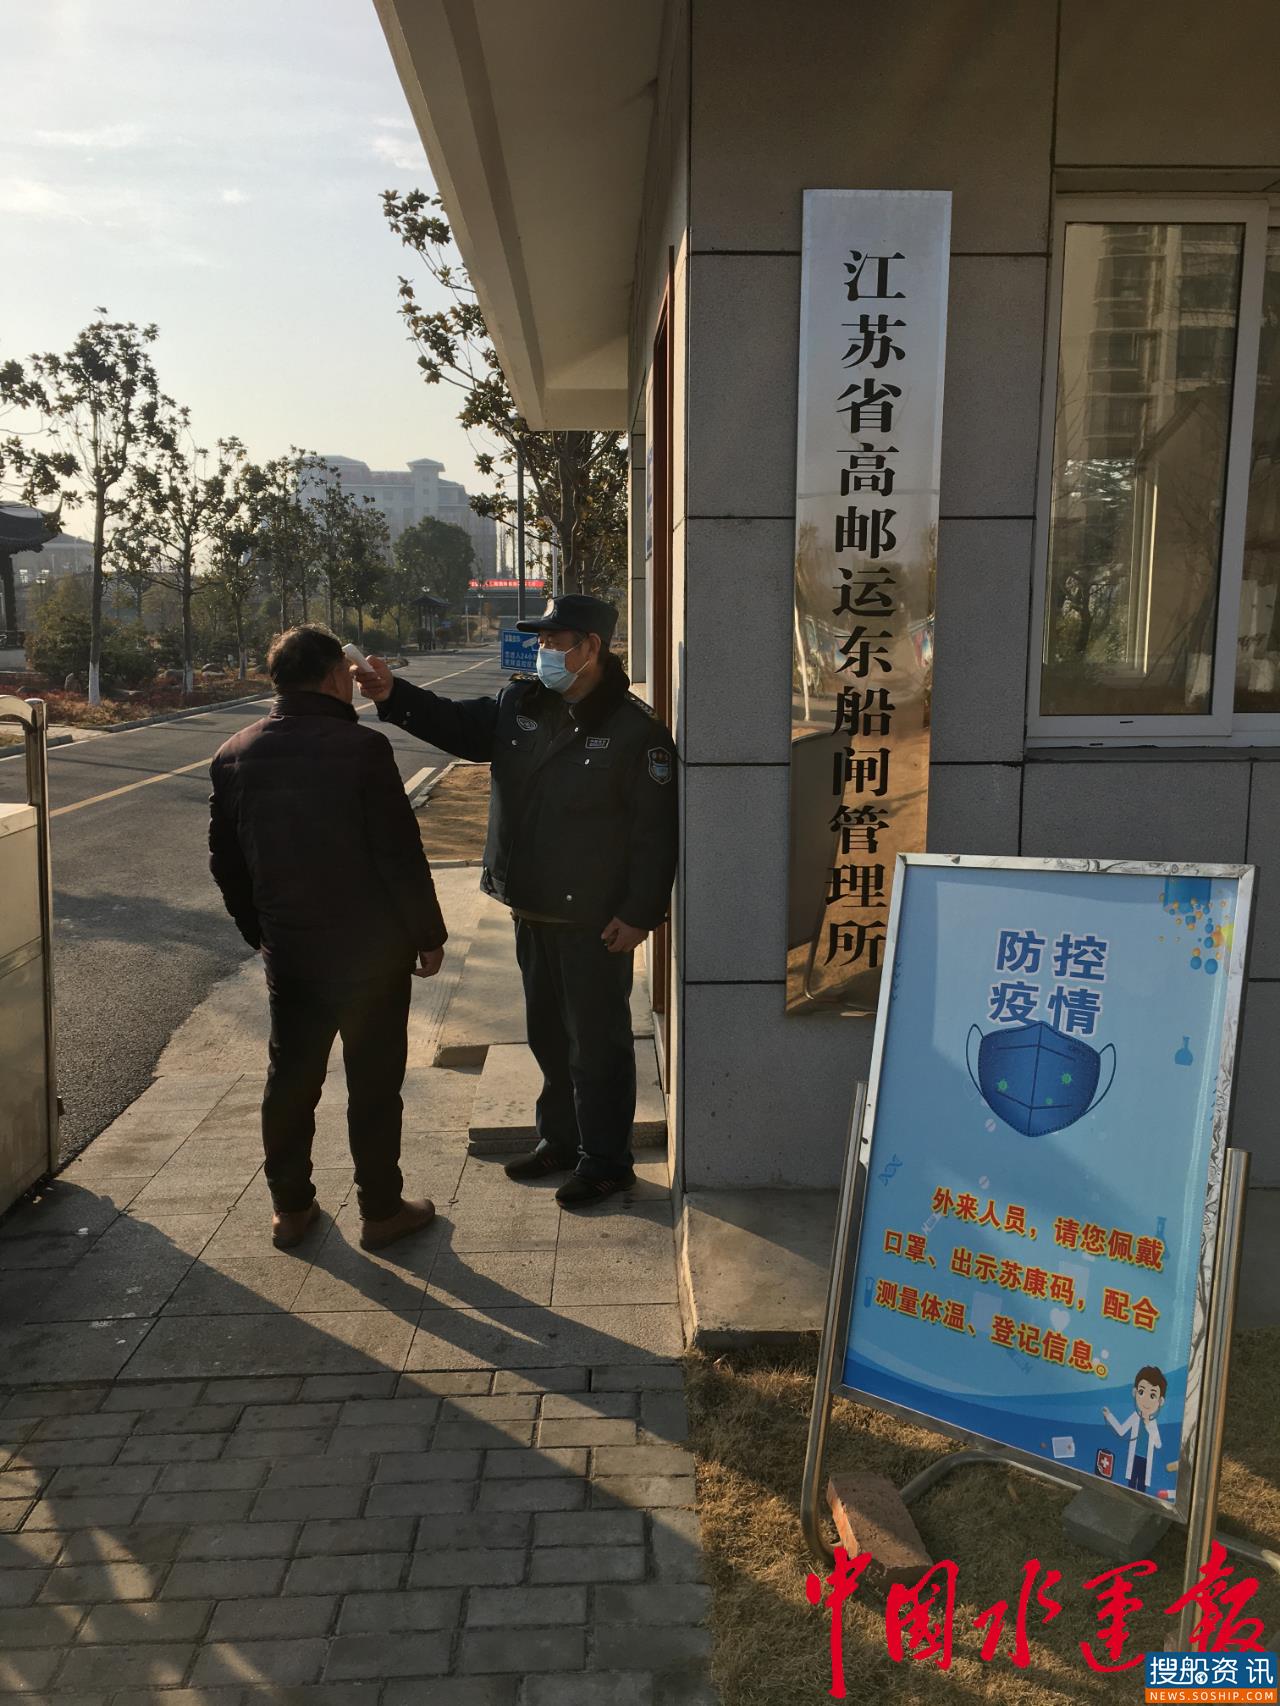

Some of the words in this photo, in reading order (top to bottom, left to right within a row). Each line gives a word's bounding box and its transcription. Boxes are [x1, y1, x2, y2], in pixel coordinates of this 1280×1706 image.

[824, 250, 906, 968] 江苏省高邮运东船闸管理所
[996, 929, 1108, 982] 防控
[989, 981, 1103, 1035] 疫情
[931, 1186, 1164, 1271] 外来人员，请您佩戴
[883, 1229, 1160, 1332] 口罩、出示苏康码，配合
[875, 1279, 1110, 1378] 测量体温、登记信息。
